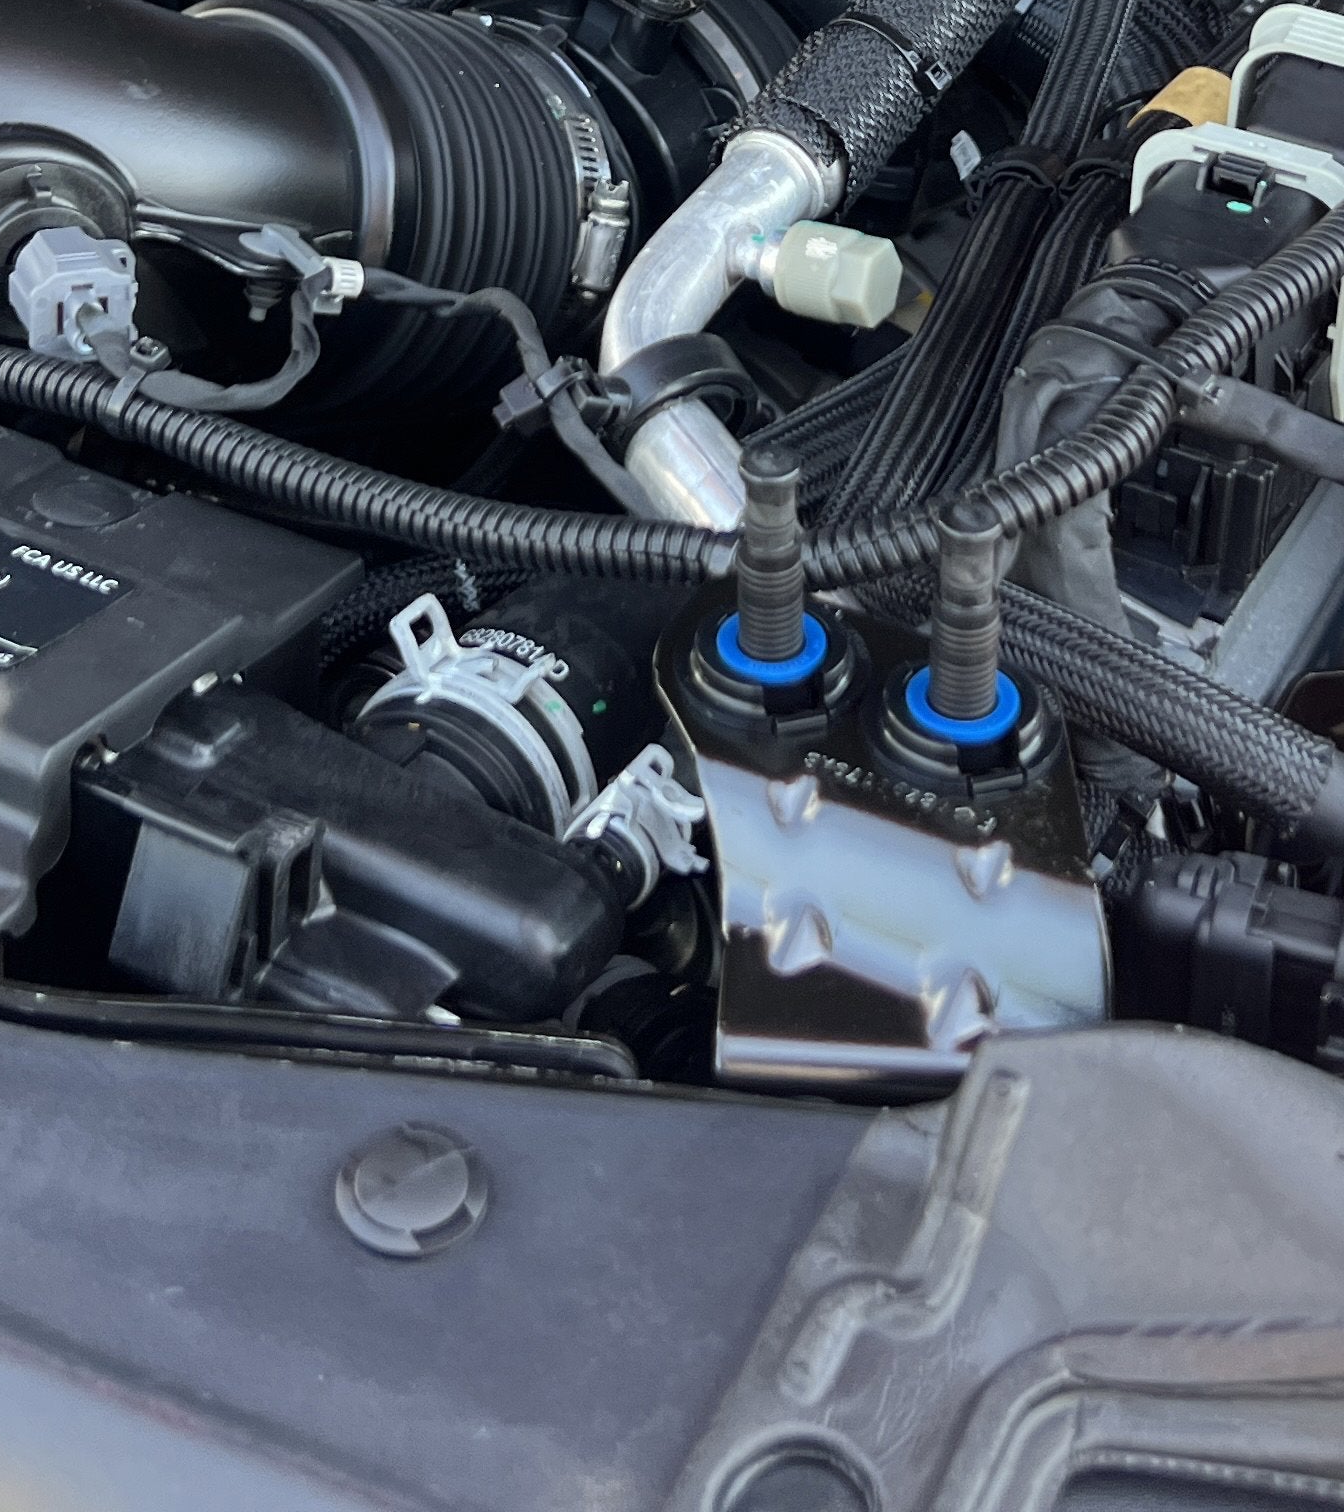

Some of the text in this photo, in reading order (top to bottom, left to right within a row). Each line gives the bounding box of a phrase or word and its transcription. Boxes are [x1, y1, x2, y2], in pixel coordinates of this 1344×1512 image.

[10, 545, 119, 595] FCA US LLC
[459, 627, 570, 682] 68280781D
